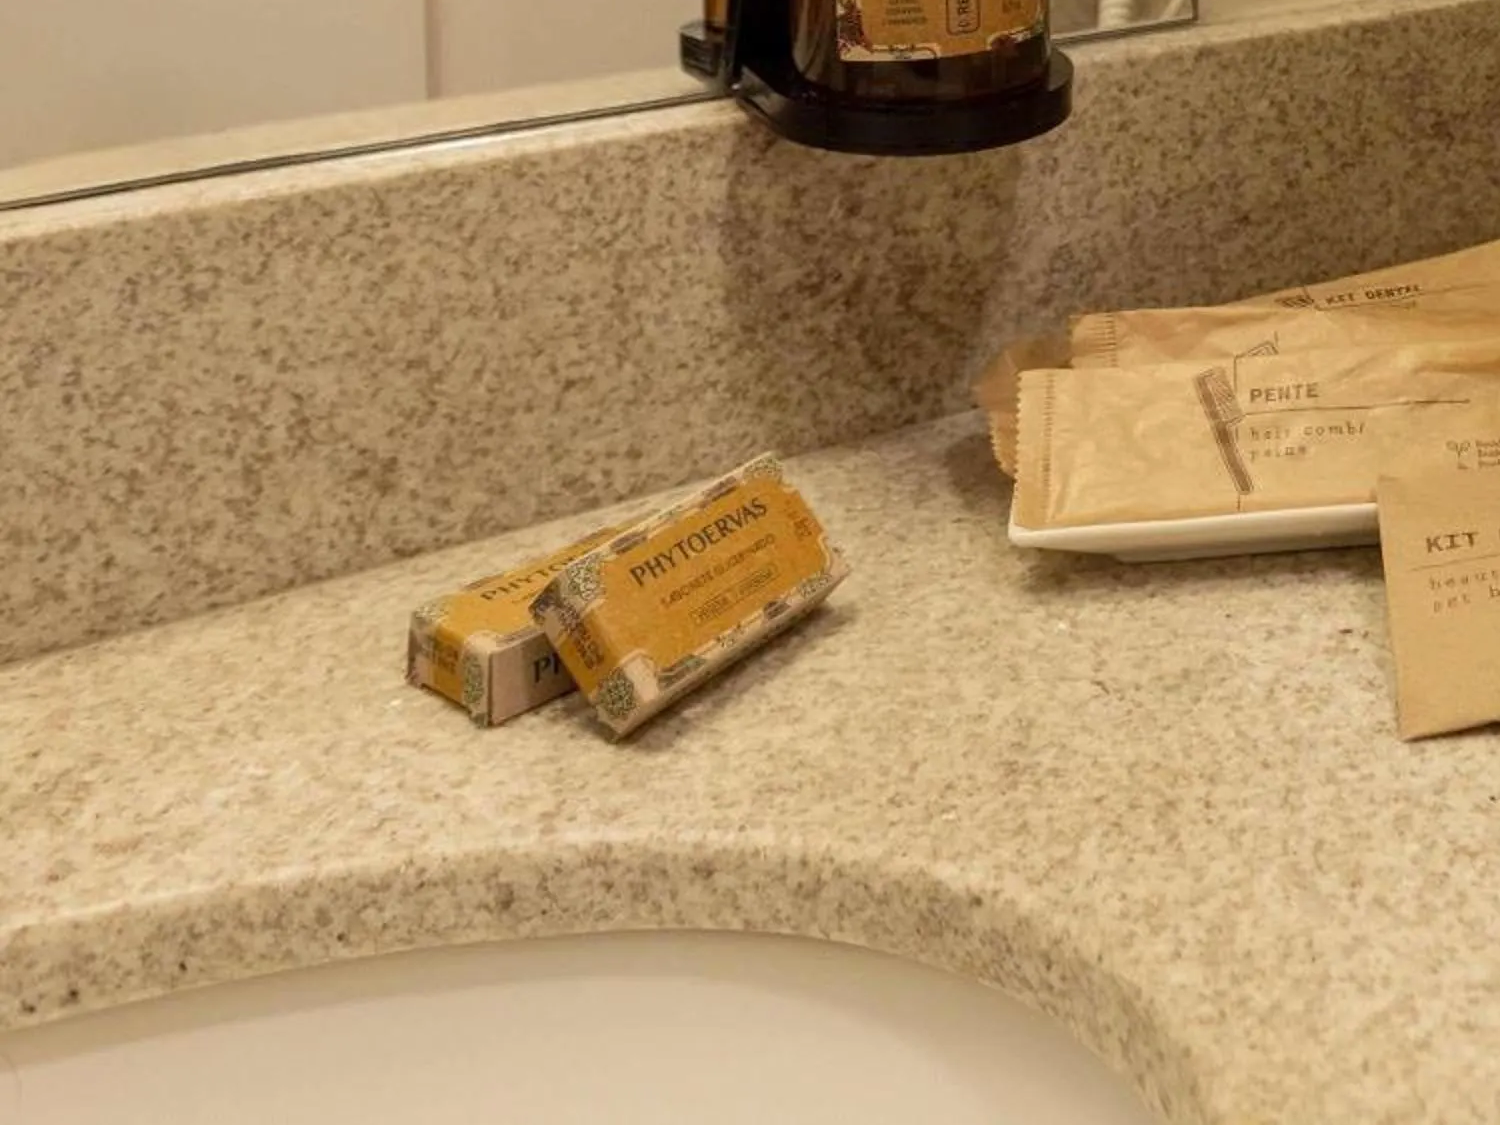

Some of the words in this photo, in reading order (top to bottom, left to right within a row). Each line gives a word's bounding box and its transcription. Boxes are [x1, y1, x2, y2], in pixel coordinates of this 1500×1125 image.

[1250, 382, 1320, 404] PENTE
[629, 496, 768, 588] PHYTOERVAS
[1425, 530, 1480, 554] KIT
